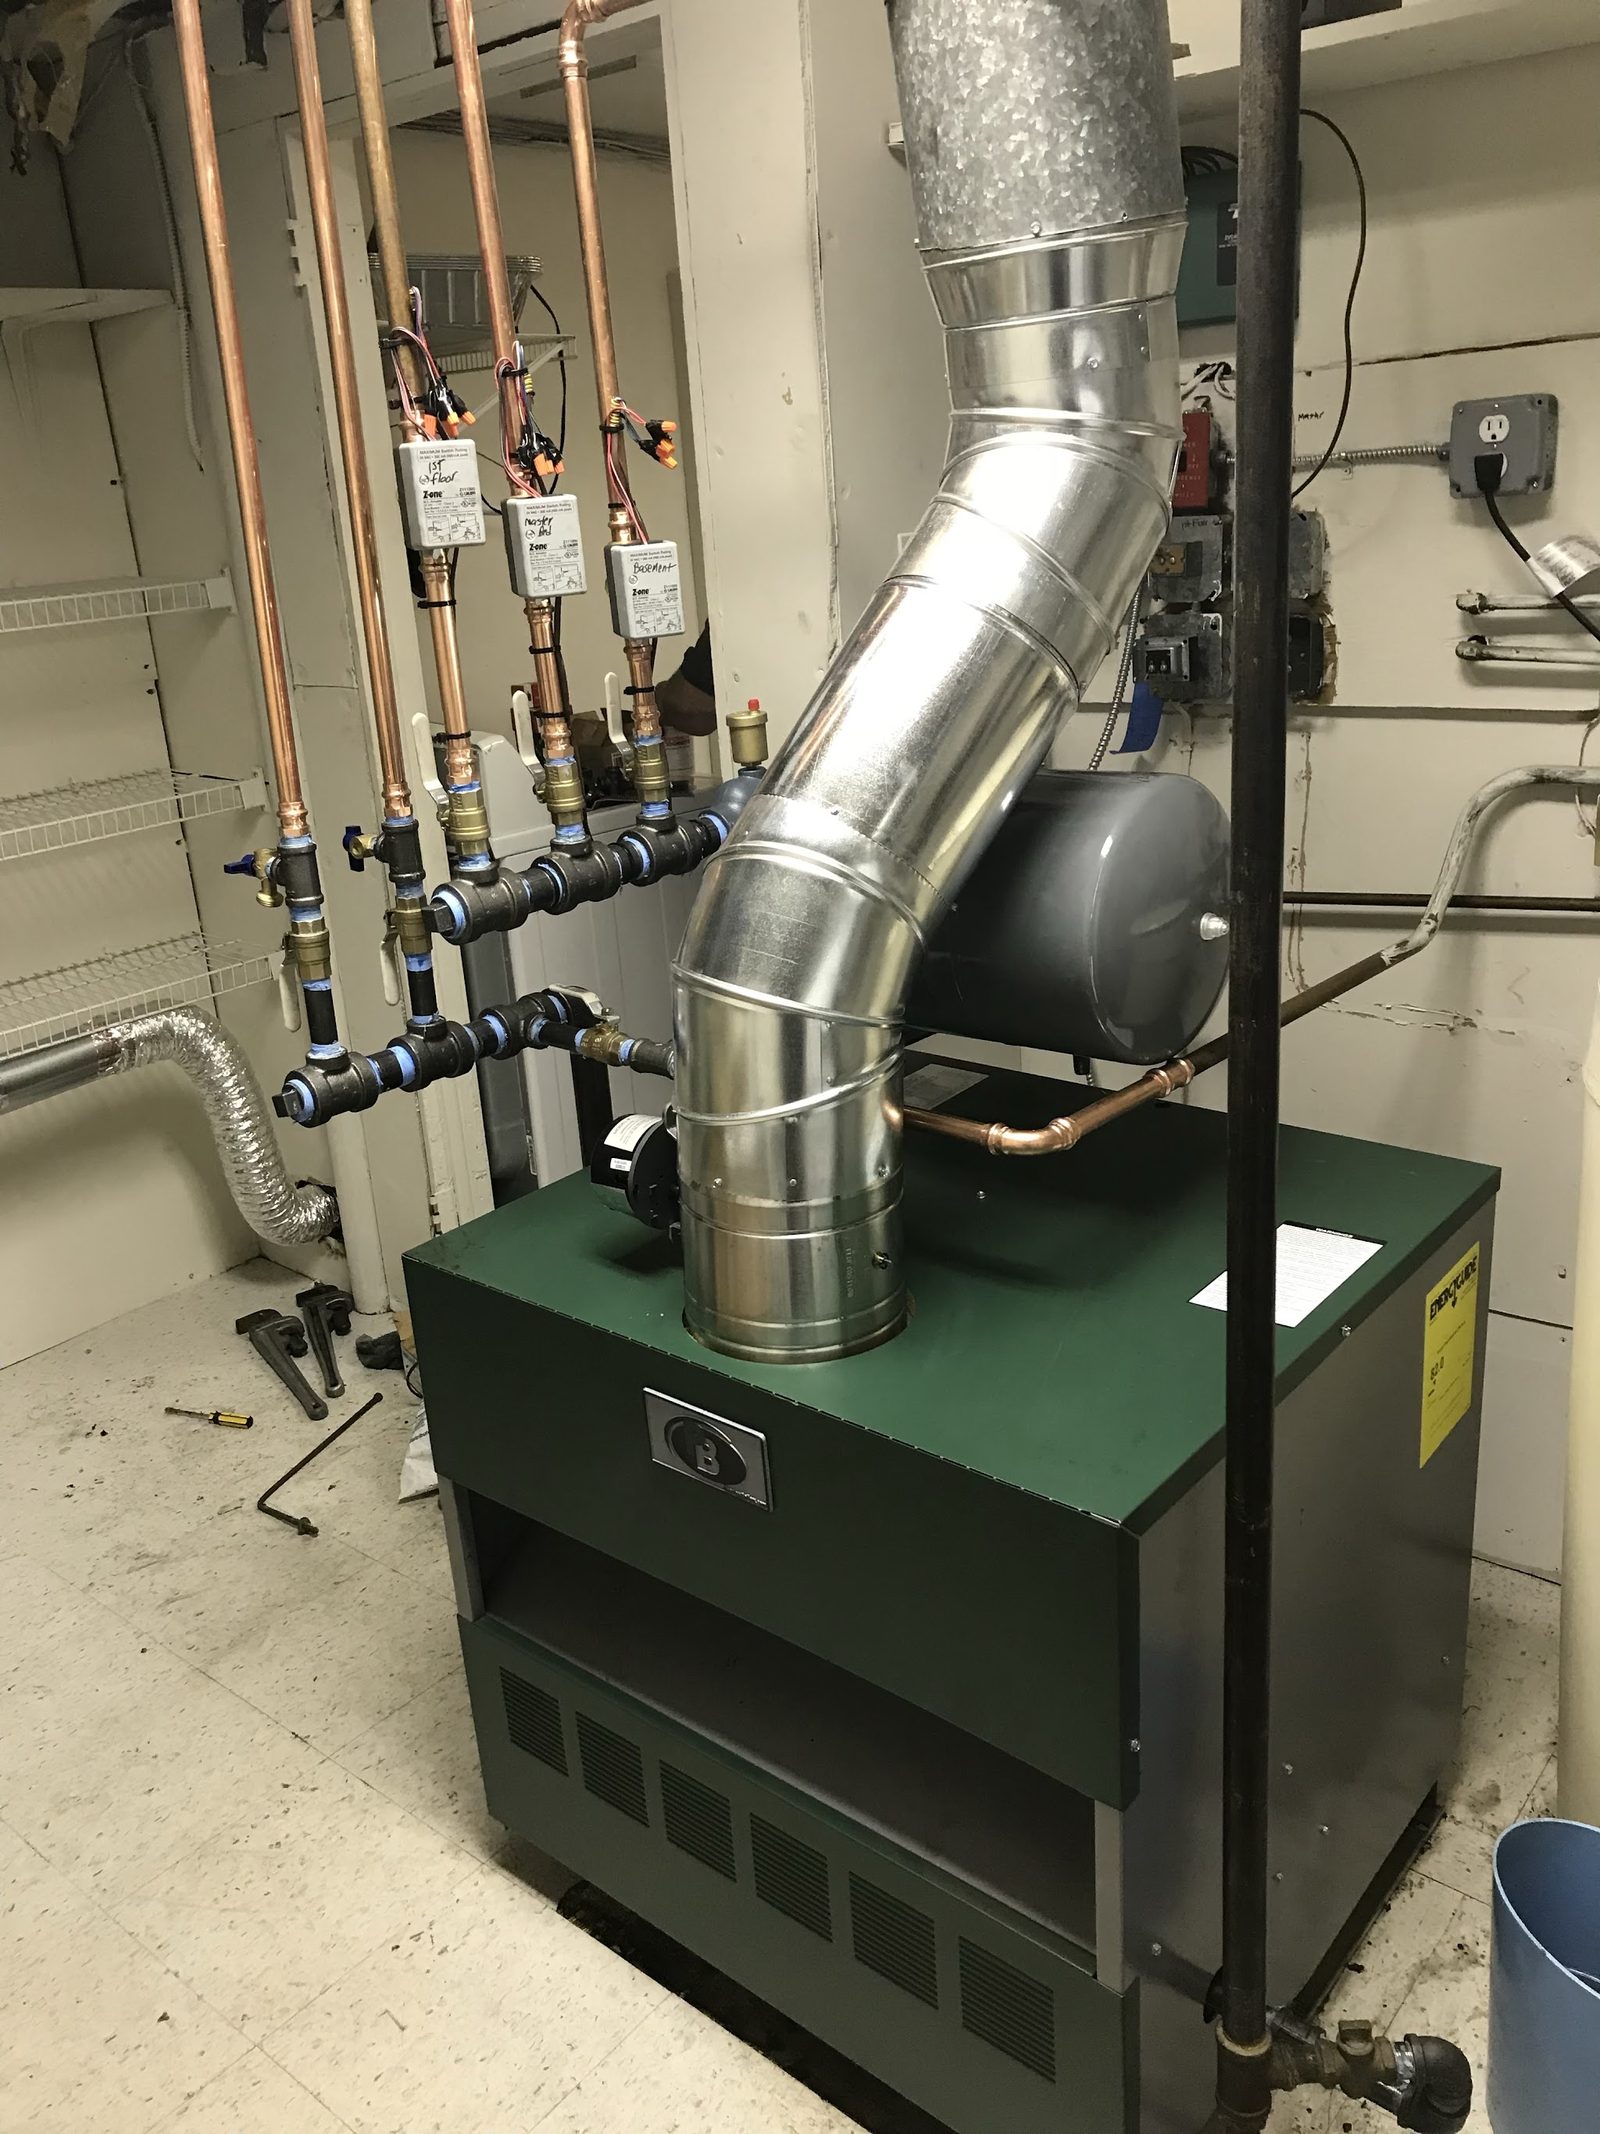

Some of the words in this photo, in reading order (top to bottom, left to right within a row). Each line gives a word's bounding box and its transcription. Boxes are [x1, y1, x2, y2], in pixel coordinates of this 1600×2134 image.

[423, 490, 443, 499] Z-one
[529, 543, 548, 551] Z-one
[632, 588, 650, 596] Z-one
